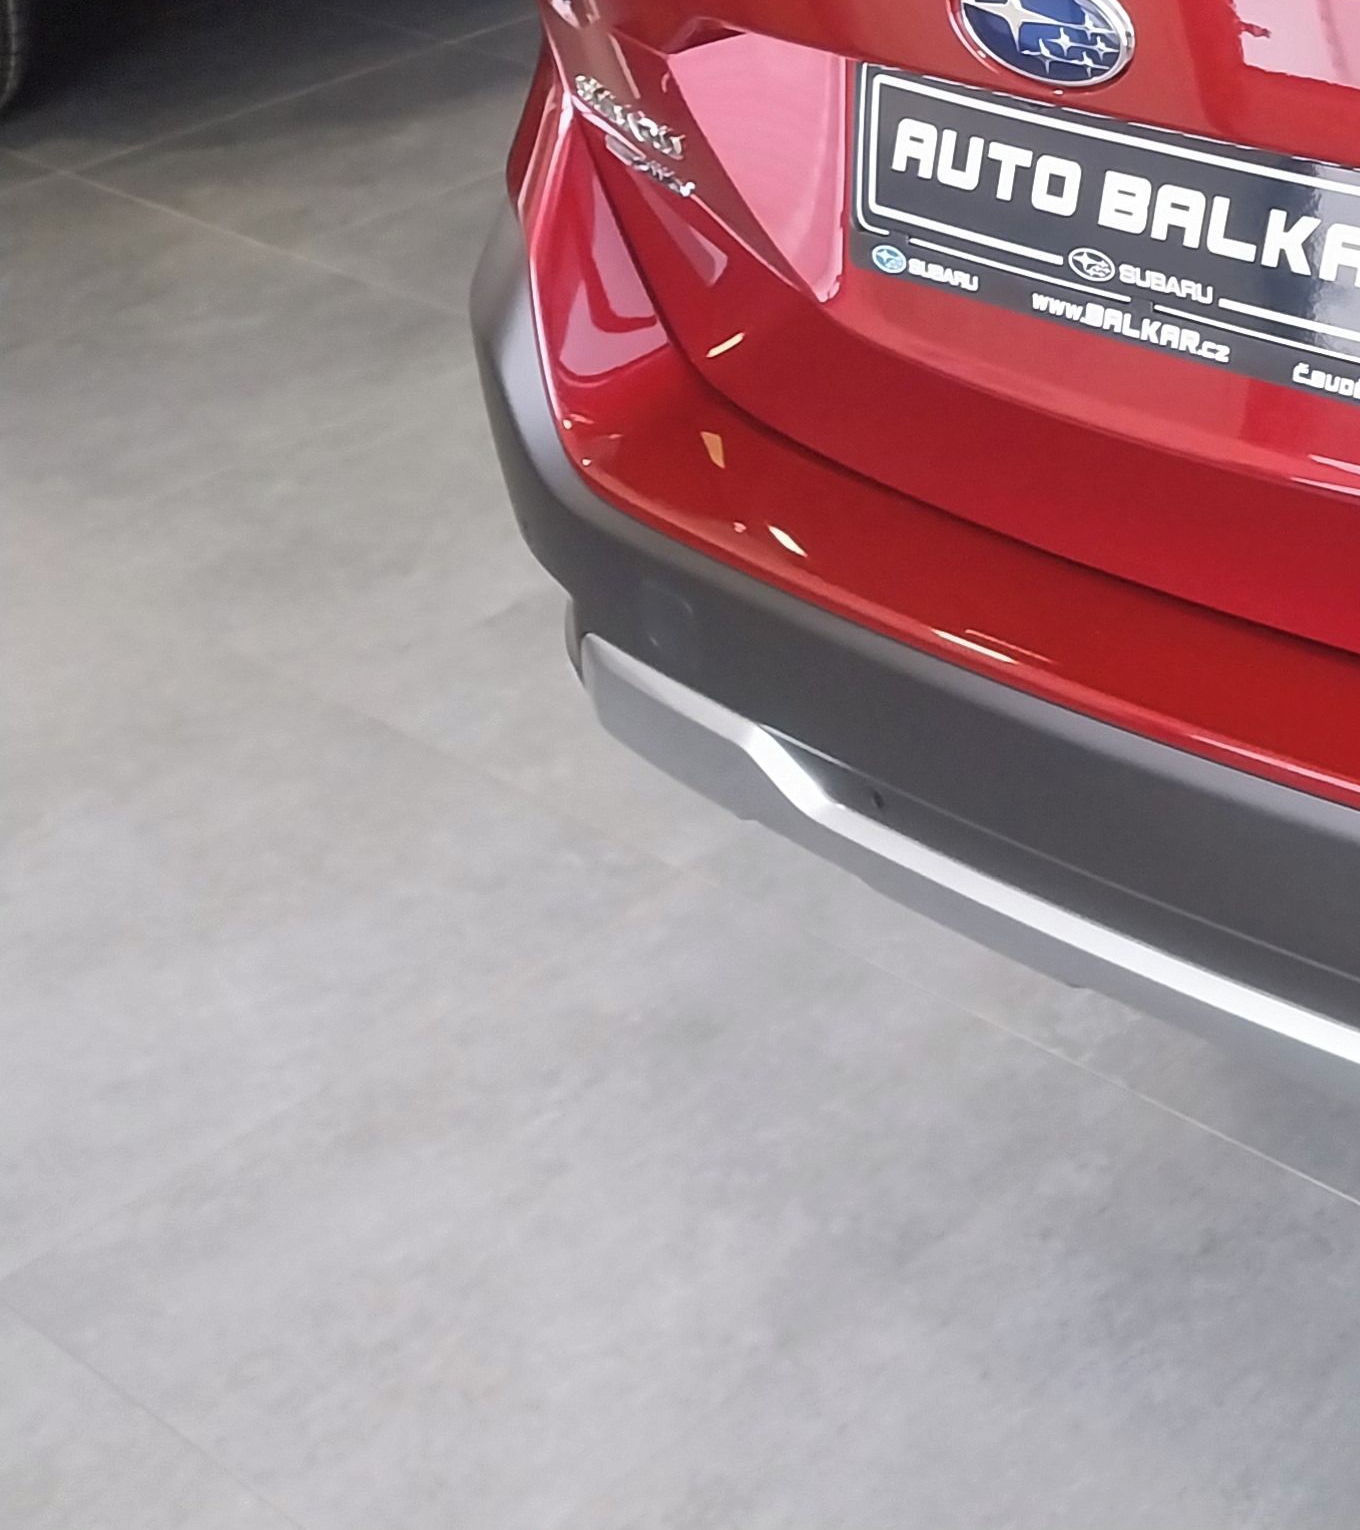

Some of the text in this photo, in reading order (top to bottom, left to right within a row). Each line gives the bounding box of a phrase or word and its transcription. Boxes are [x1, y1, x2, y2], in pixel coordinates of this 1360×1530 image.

[891, 117, 1082, 217] AUTO
[907, 257, 979, 292] SUBARU
[1118, 263, 1214, 305] SUBARU
